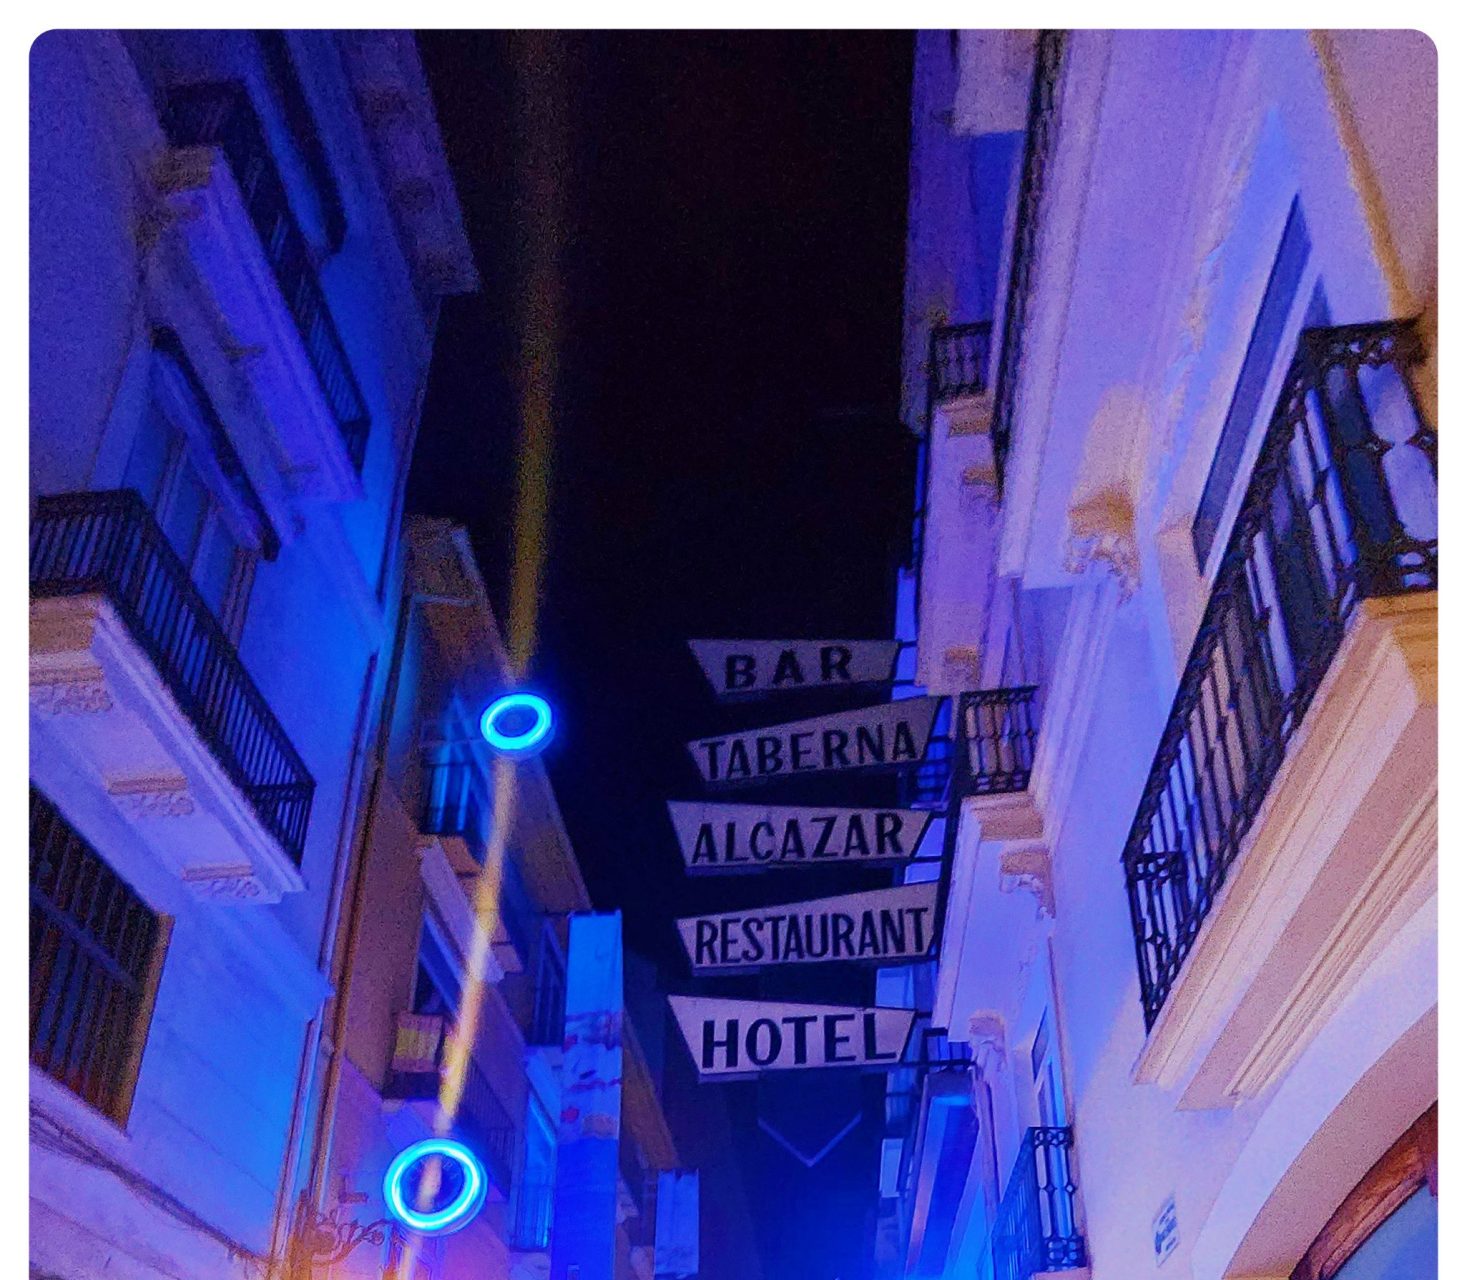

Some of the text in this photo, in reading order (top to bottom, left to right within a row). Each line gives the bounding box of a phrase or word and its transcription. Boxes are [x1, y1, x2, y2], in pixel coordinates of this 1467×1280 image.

[725, 646, 852, 690] BAR
[700, 720, 917, 780] TABERNA
[691, 813, 905, 864] ALCAZAR
[694, 907, 929, 965] RESTAURANT
[701, 1012, 898, 1069] HOTEL
